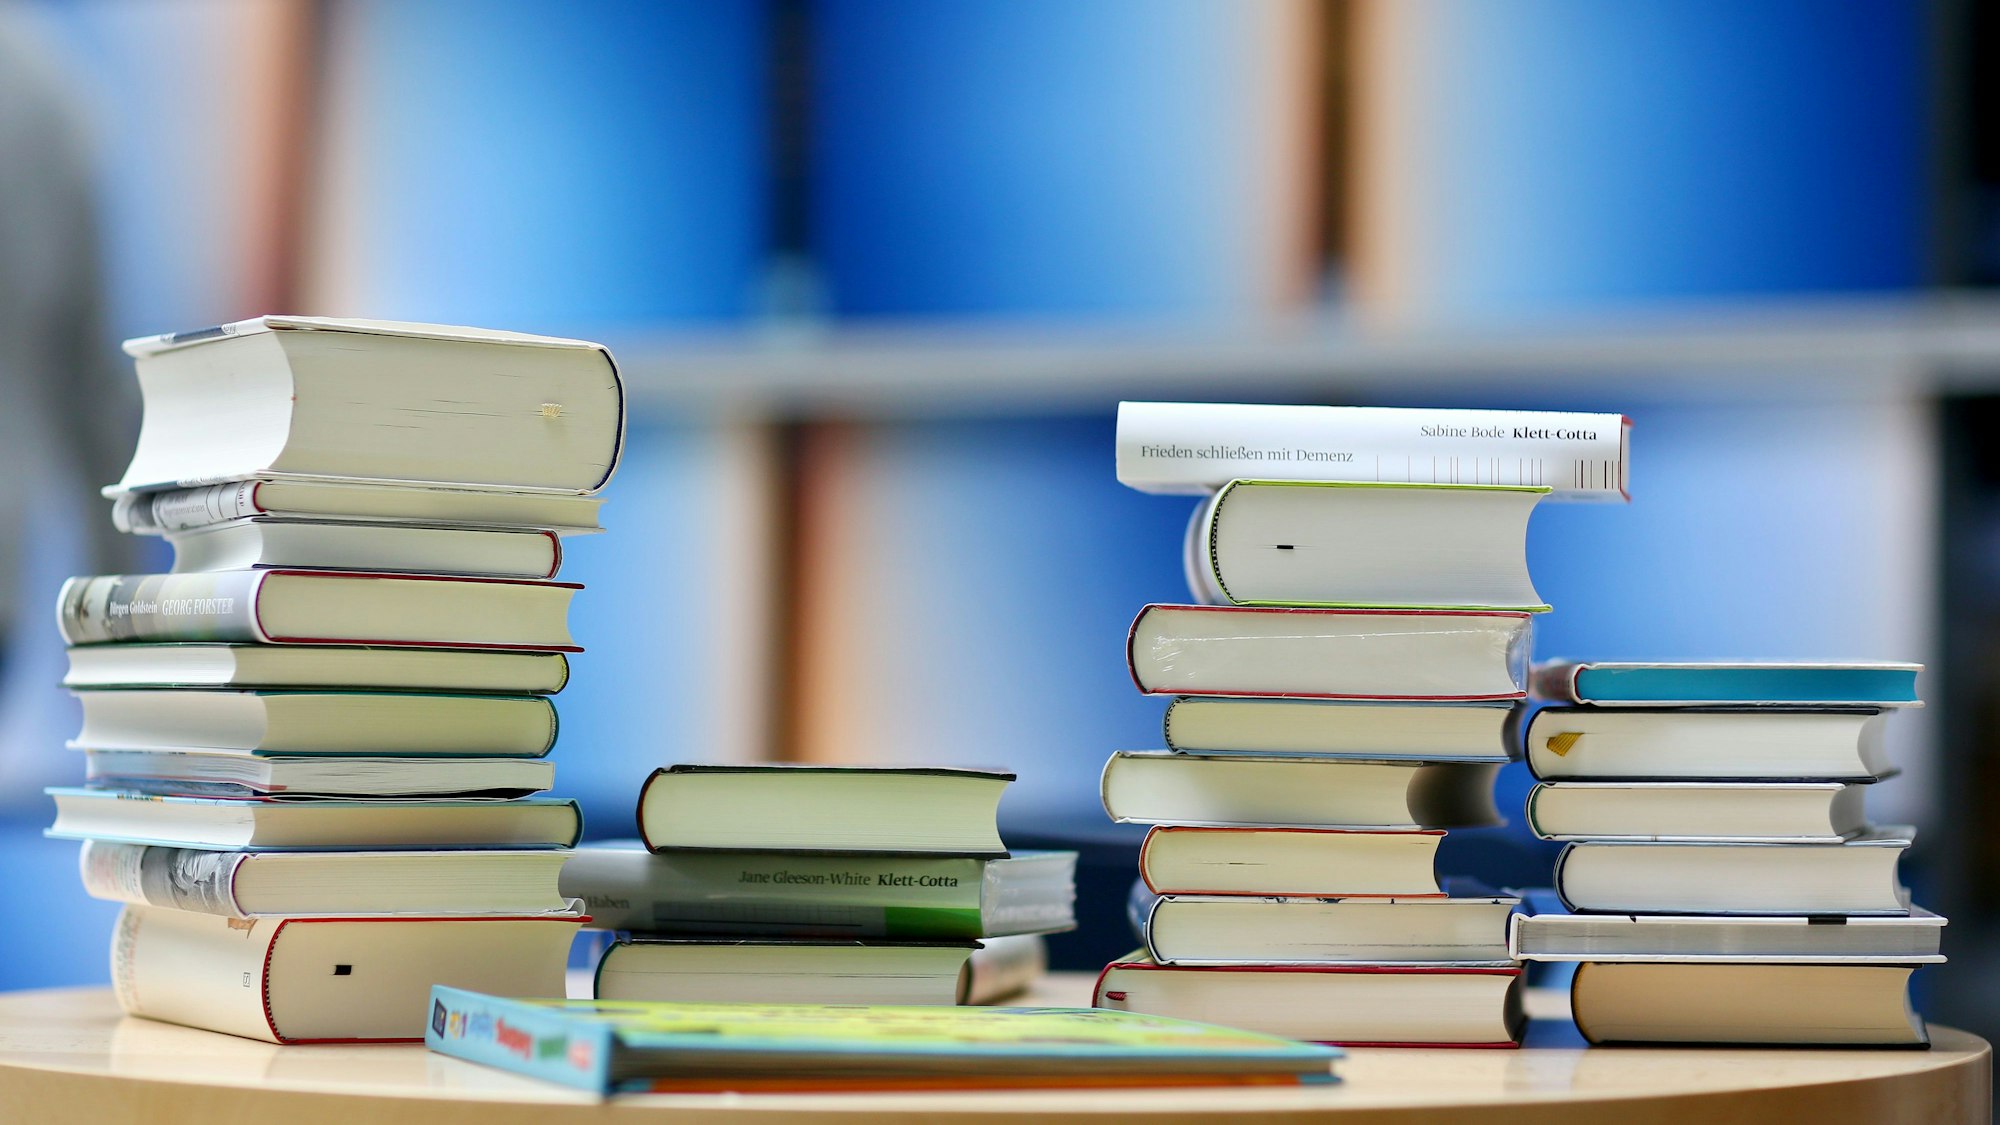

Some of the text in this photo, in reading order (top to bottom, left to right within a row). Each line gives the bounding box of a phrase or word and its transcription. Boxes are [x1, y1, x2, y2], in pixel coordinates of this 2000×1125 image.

[1420, 425, 1598, 441] Sabine Bode Klett-Cotta
[1141, 444, 1354, 463] Frieden schließen mit Demenz
[129, 600, 158, 615] Goldstein
[162, 599, 192, 616] GEORG
[193, 598, 234, 615] FORSTER
[738, 870, 958, 888] Jane Gleeson-White Klett-Cotta
[588, 893, 631, 910] Haben
